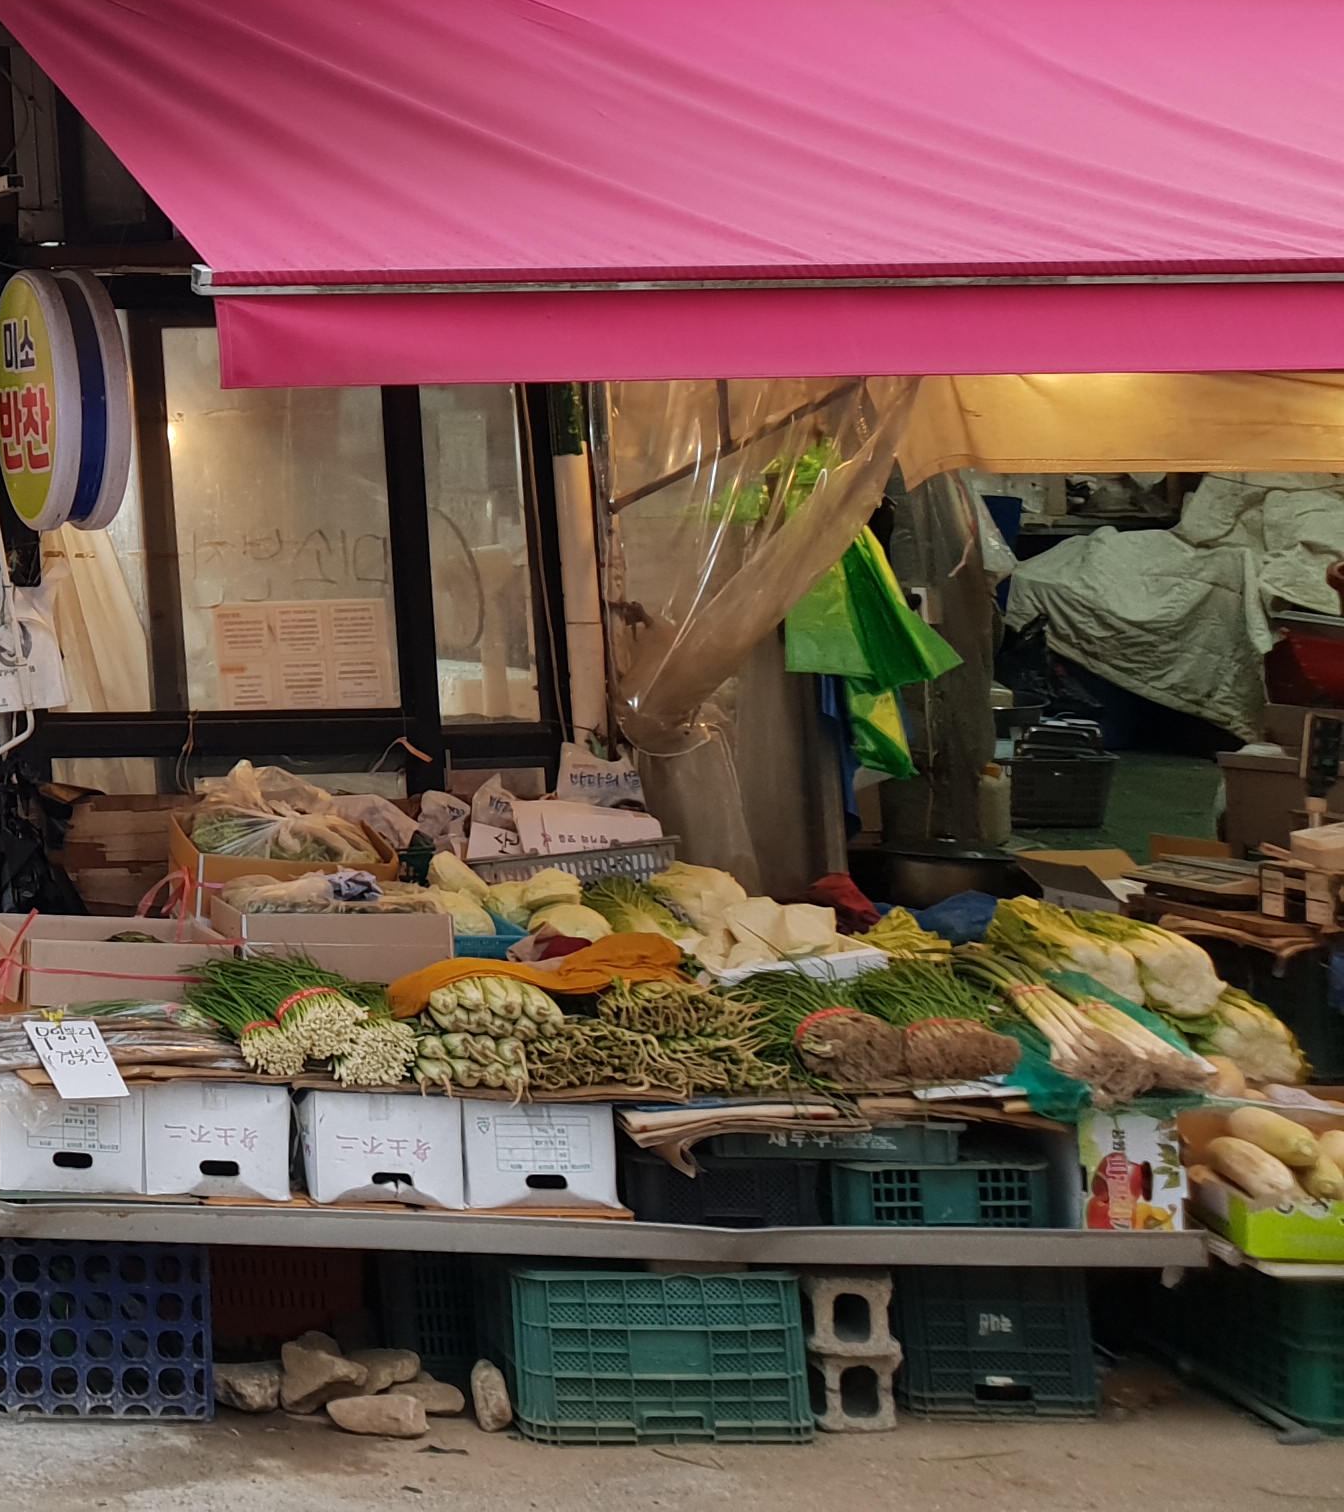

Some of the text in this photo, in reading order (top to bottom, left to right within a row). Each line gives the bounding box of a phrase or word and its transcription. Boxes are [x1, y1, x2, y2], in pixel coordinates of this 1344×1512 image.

[2, 318, 37, 370] 미소
[163, 1123, 260, 1153] 身土不二
[335, 1134, 433, 1163] 身土不二
